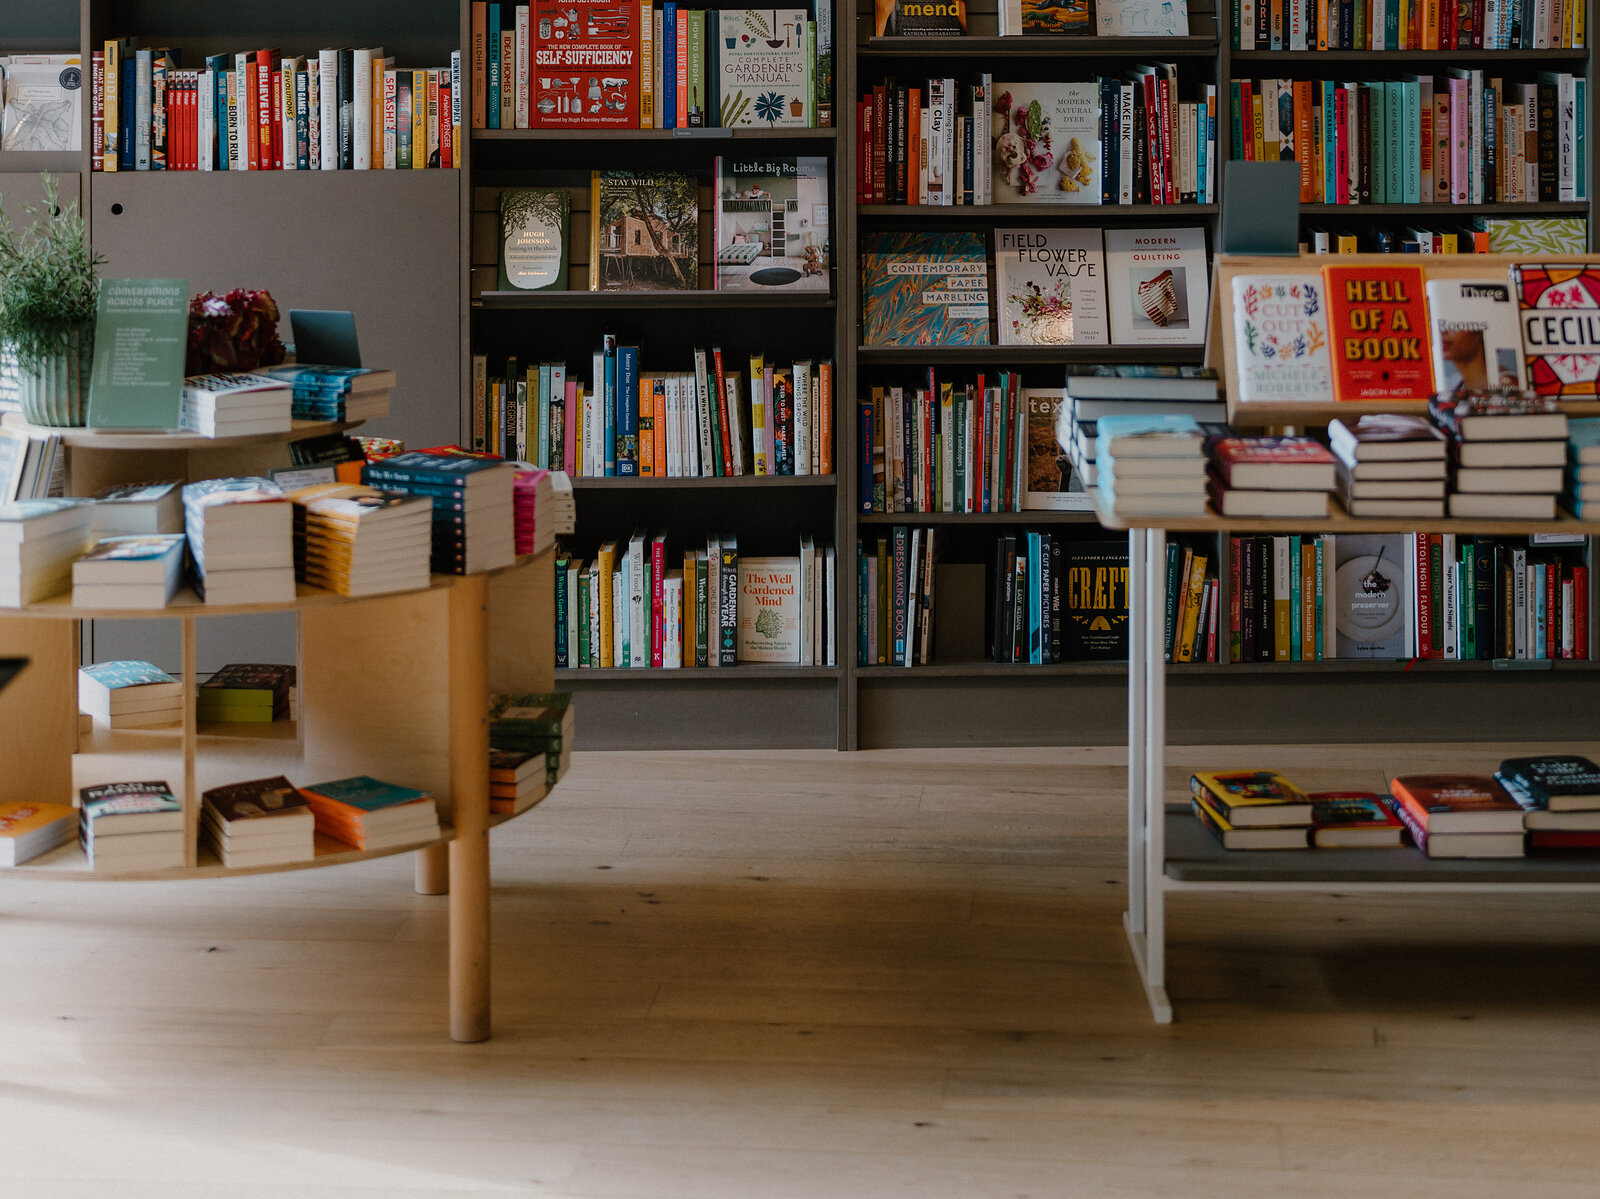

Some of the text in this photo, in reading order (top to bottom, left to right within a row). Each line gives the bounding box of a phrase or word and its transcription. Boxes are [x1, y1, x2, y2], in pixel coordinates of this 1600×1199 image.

[904, 1, 960, 17] mend
[536, 50, 633, 65] SELF-SUFFICIENCY
[725, 64, 803, 73] GARDENER'S
[737, 73, 790, 82] MANUAL
[259, 65, 269, 125] BELIEVE US
[386, 78, 394, 123] SPLASH!
[932, 109, 942, 132] Clay
[1123, 92, 1131, 141] MAKE INK
[229, 105, 238, 161] BORN TO RUN
[733, 162, 816, 177] Little Big Rooms
[1003, 234, 1047, 248] FIELD
[1018, 249, 1087, 262] FLOWER
[1133, 253, 1180, 261] QUILTING
[891, 264, 983, 273] CONTEMPORARY
[1045, 264, 1096, 277] VASE
[108, 287, 180, 295] CONVERSATIONS
[951, 279, 984, 288] PAPER
[1345, 280, 1409, 302] HELL
[926, 293, 984, 302] MARBLING
[1461, 285, 1508, 302] Three
[107, 297, 175, 306] ACROSS PLACE
[1349, 308, 1410, 331] OF A
[1438, 319, 1489, 331] Rooms
[1527, 317, 1600, 345] CECIL
[1344, 337, 1420, 360] BOOK
[507, 401, 516, 436] REGROWN
[746, 573, 792, 584] The Well
[1419, 533, 1428, 635] OTTOLENGHI FLAVOUR
[744, 585, 794, 595] Gardened
[896, 539, 905, 637] DRESSMAKING BOOK
[755, 597, 782, 606] Mind
[1351, 602, 1390, 610] preserver
[721, 603, 729, 627] YEAR
